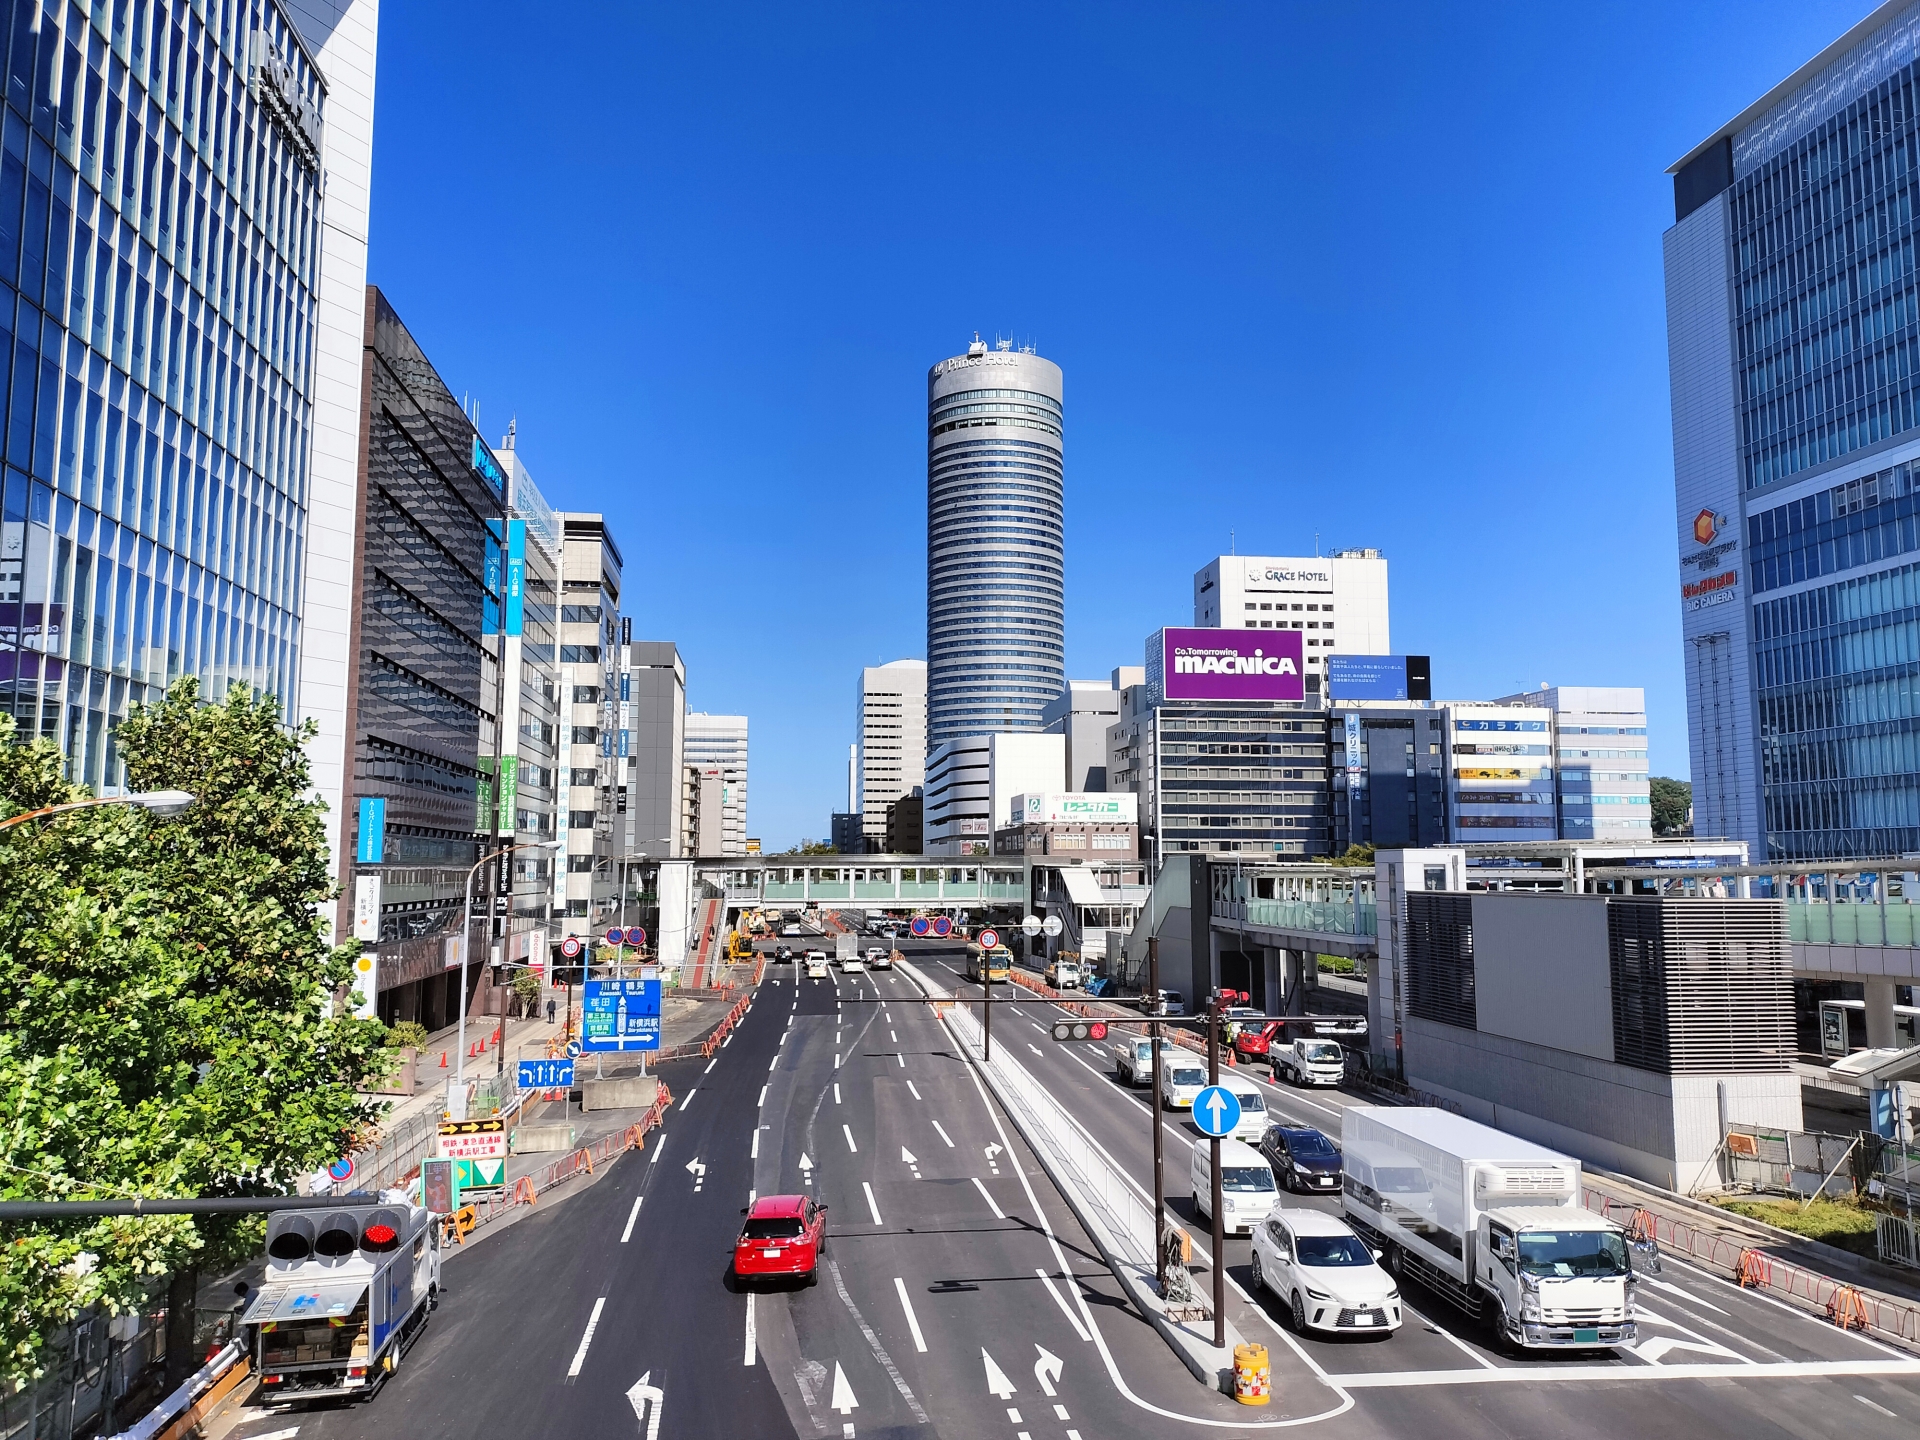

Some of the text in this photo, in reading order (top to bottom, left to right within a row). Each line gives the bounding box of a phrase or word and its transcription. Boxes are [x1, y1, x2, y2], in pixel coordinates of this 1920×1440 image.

[947, 354, 1018, 373] Prince Hotel
[1265, 570, 1328, 582] GRACE HOTEL
[1687, 590, 1734, 611] BIC CAMERA
[1174, 647, 1237, 657] Co.Tomorrowing
[1478, 721, 1541, 730] カラオケ
[1066, 803, 1117, 812] レンタカー
[983, 935, 995, 944] 50
[566, 943, 576, 951] 50
[601, 981, 645, 990] 川崎 鶴見
[629, 1018, 658, 1027] 新横浜駅
[442, 1135, 501, 1148] 相鉄・東急直通線
[448, 1146, 496, 1157] 新横浜駅工事
[425, 1162, 450, 1174] 工事中
